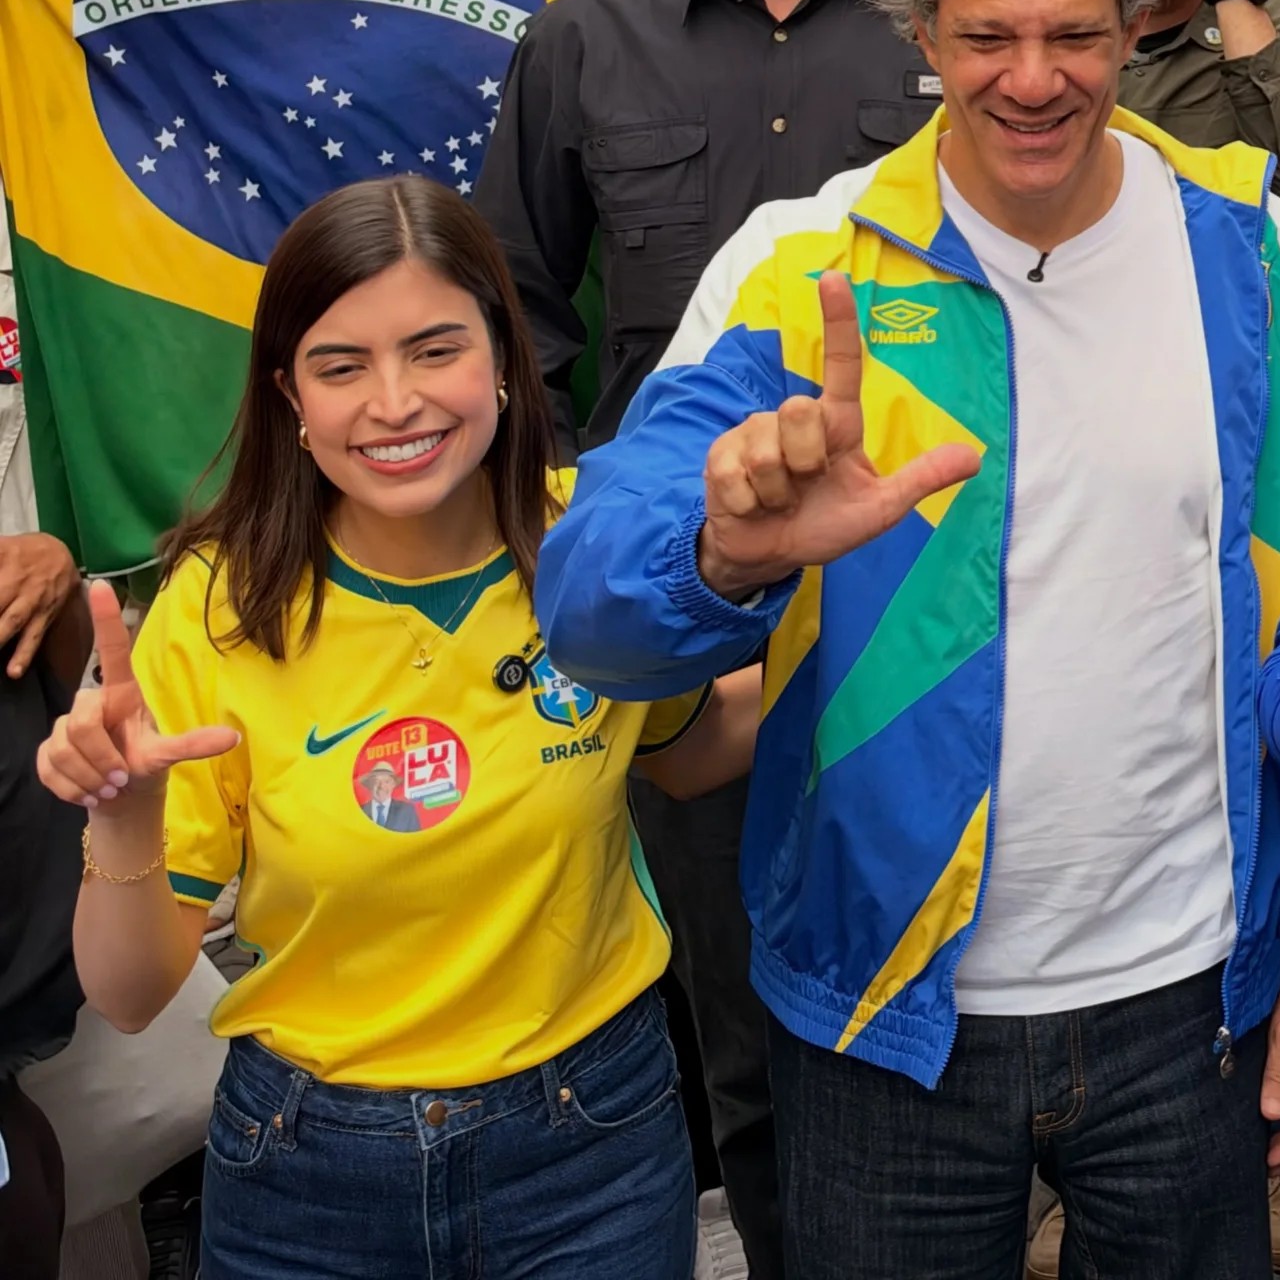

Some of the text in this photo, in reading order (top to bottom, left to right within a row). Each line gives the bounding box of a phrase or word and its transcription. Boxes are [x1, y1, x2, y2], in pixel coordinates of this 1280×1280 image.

[408, 743, 449, 771] LU
[541, 734, 606, 764] BRASIL
[407, 762, 451, 789] LA
